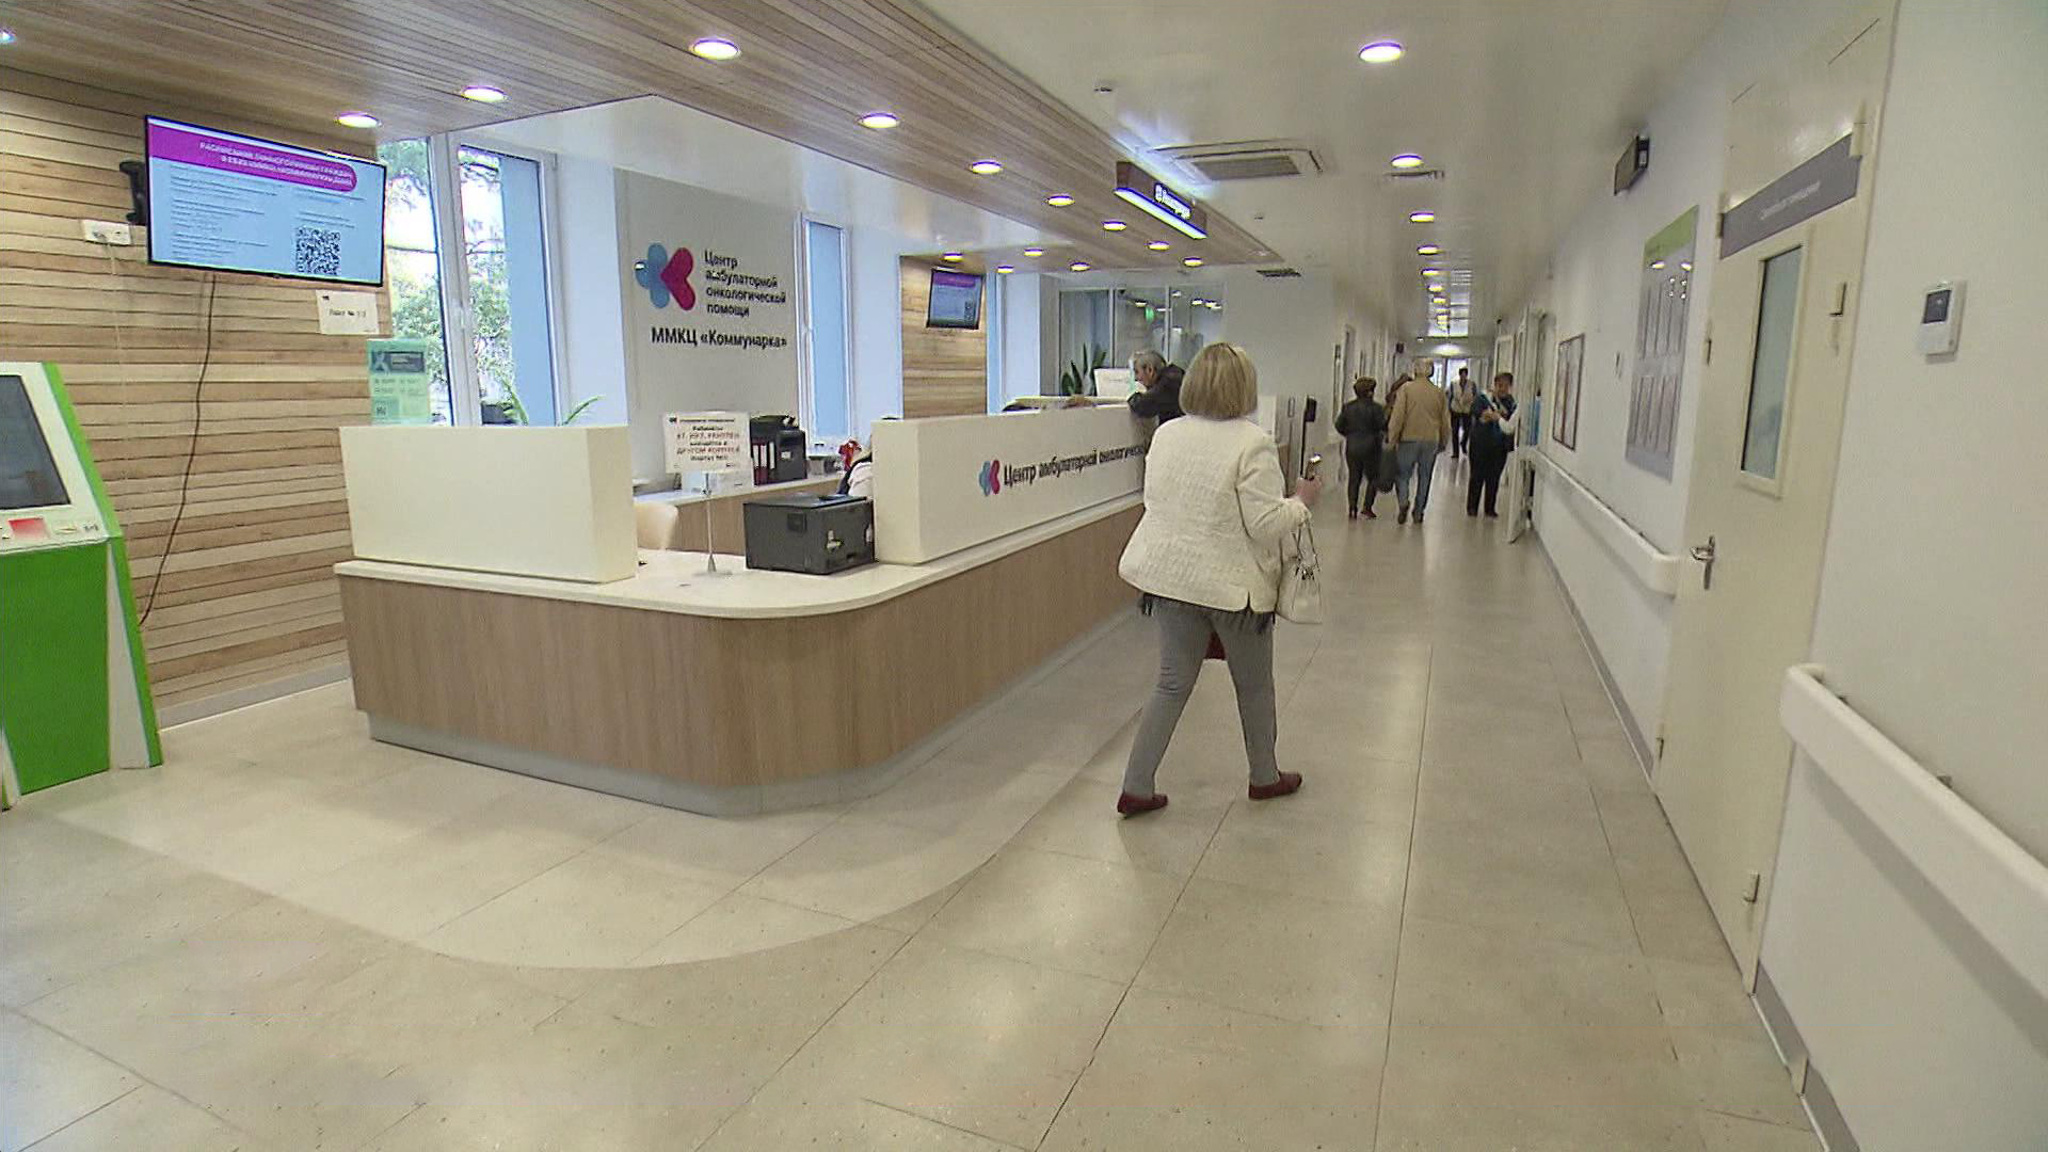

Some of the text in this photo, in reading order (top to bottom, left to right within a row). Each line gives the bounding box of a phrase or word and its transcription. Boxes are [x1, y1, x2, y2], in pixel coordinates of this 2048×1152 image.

[704, 249, 738, 269] Центр
[706, 286, 786, 304] онкологической
[706, 304, 750, 318] помощи
[651, 326, 787, 350] ММКЦ «Коммунарка»
[1003, 463, 1036, 487] Центр
